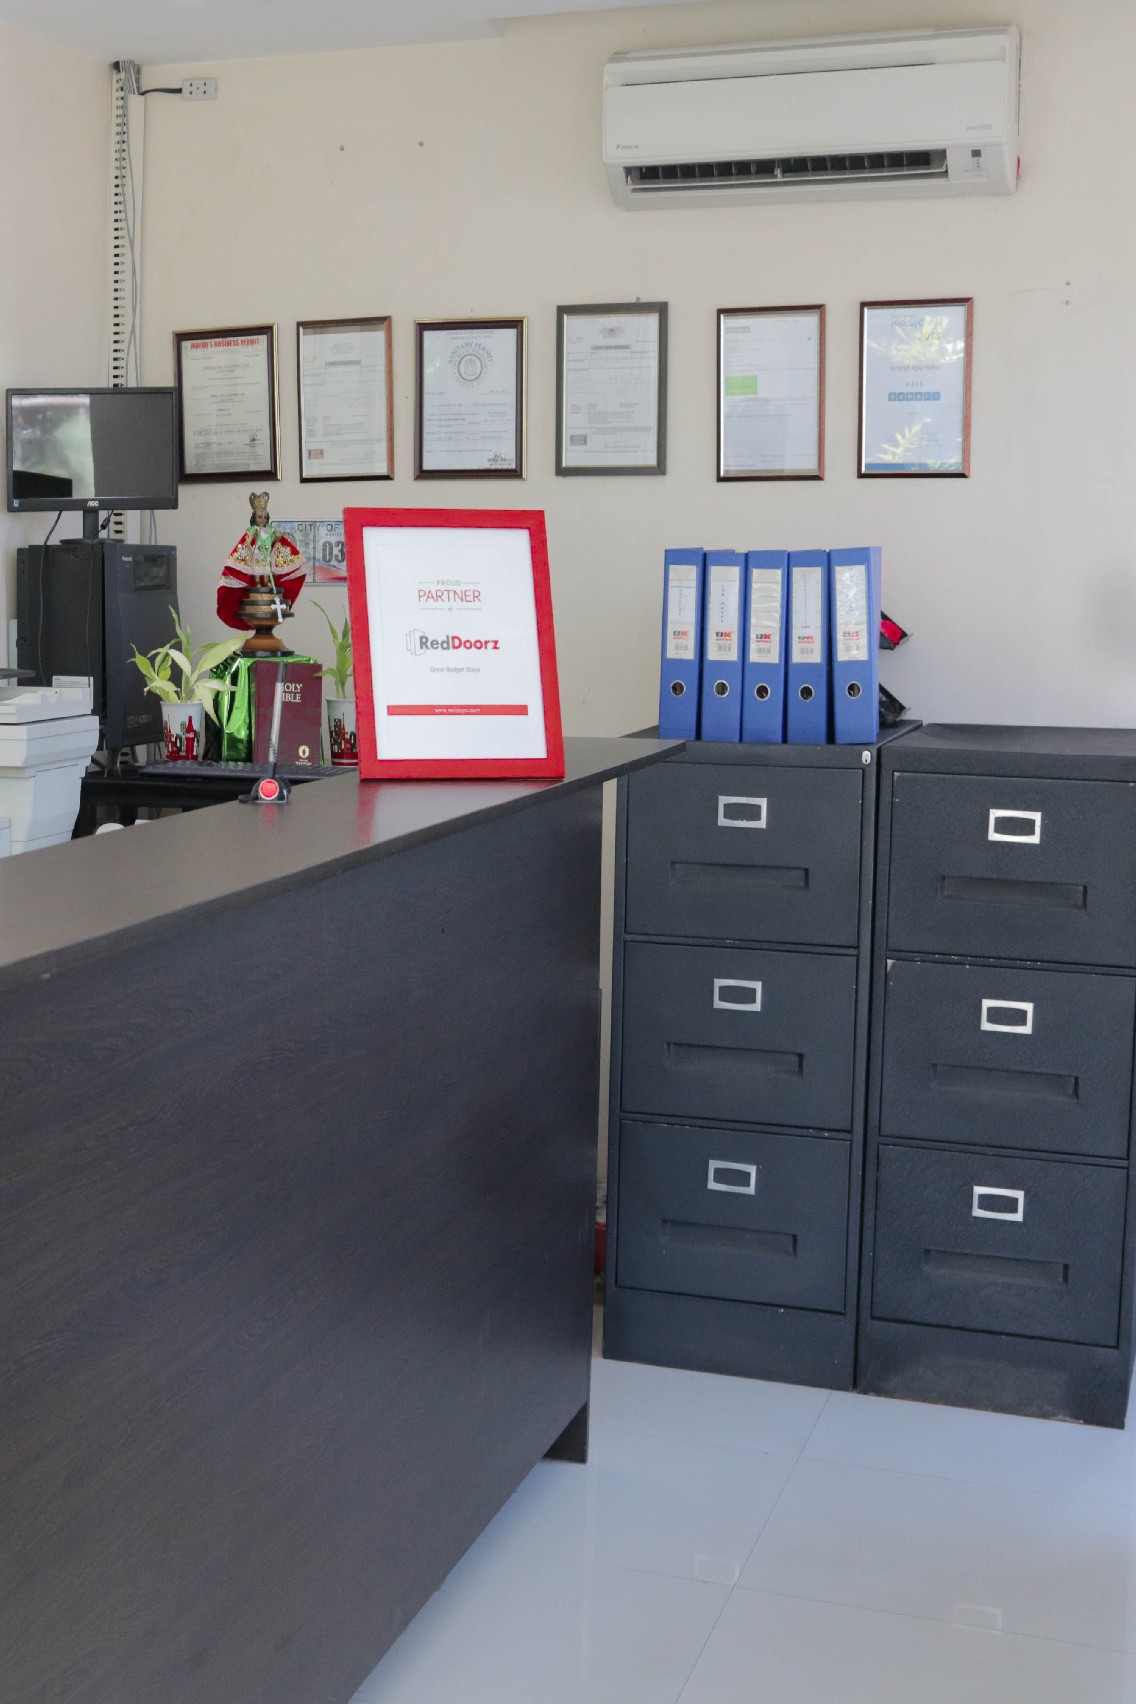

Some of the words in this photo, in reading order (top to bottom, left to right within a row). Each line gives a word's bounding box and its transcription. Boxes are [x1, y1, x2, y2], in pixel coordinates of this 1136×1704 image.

[297, 523, 321, 532] CITY
[326, 523, 340, 532] OF
[321, 540, 345, 564] 03
[436, 579, 462, 587] PROUD
[418, 589, 482, 603] PARTNER
[419, 634, 500, 651] RedDoorz
[283, 682, 303, 693] OLY
[282, 692, 302, 703] IBLE
